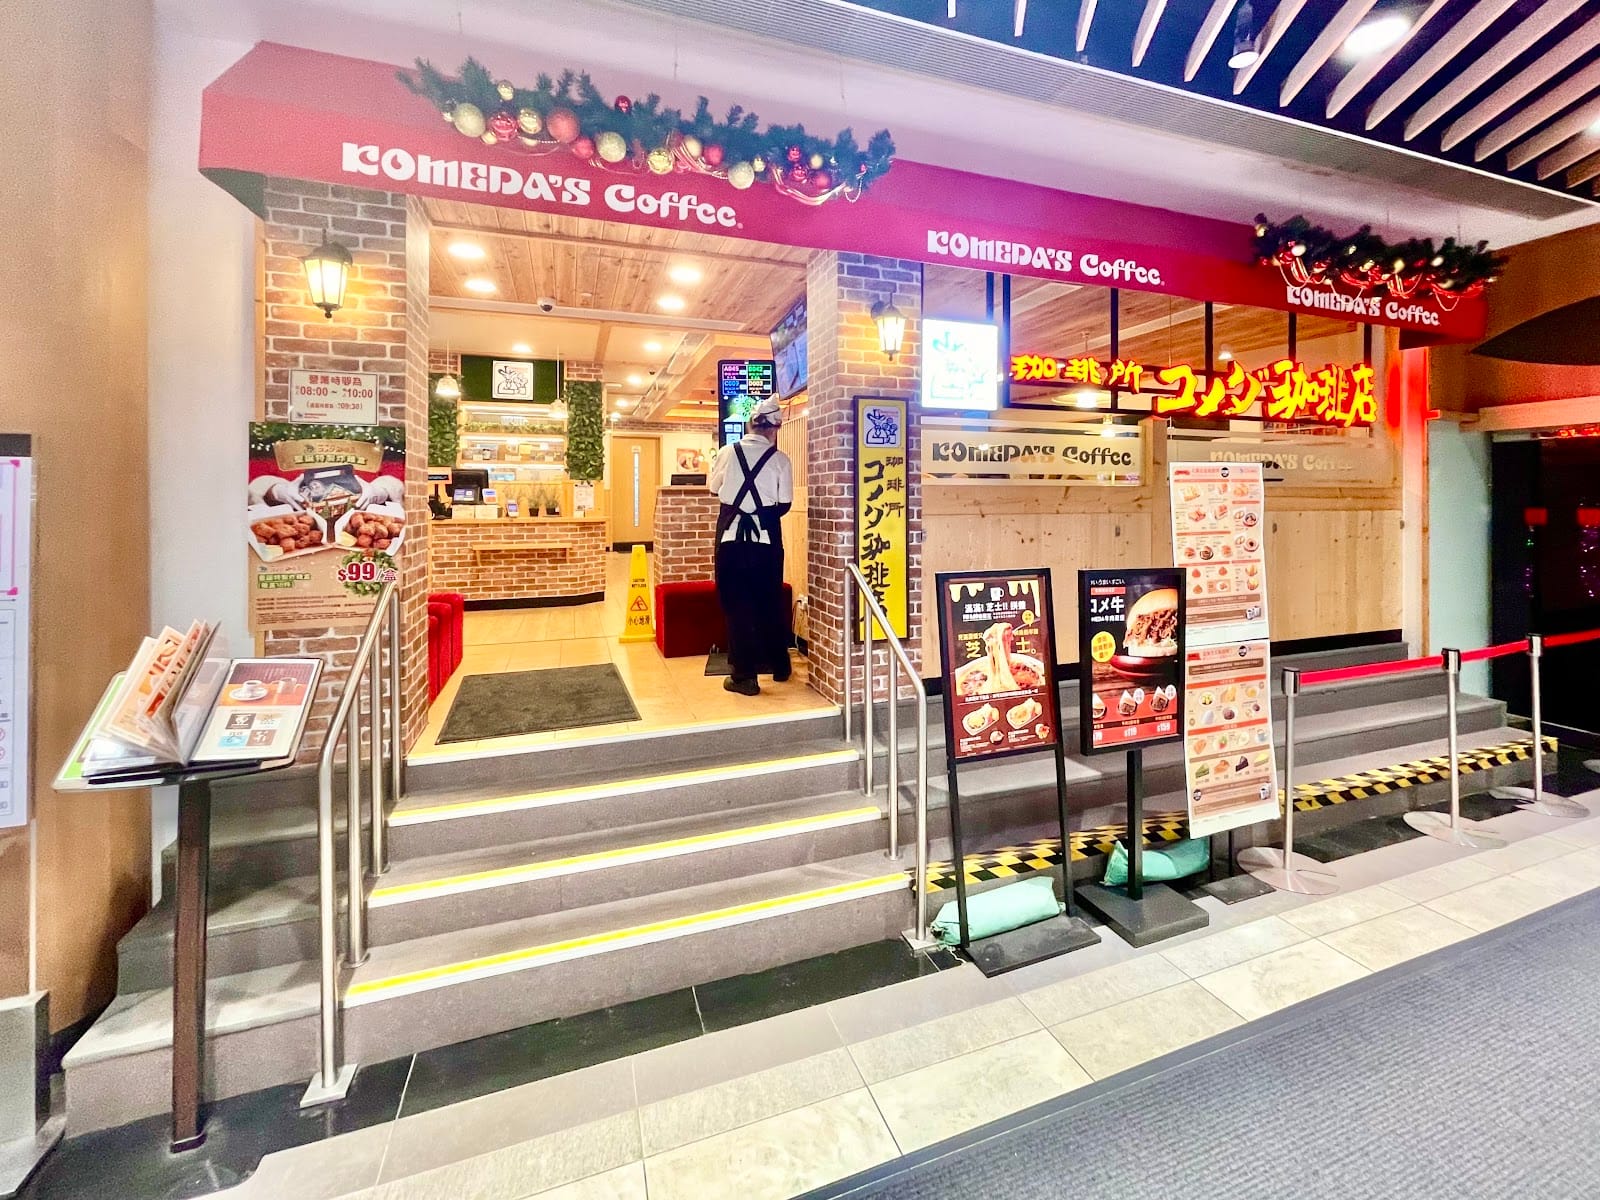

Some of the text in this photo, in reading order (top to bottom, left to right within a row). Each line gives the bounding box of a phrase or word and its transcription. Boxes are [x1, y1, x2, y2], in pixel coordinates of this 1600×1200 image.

[341, 142, 738, 227] KOMEDA'S Coffee
[927, 229, 1162, 286] KOMEDA'S Coffee
[1286, 285, 1440, 326] KOMEDA'S Coffee
[300, 386, 329, 397] 08:00
[347, 388, 373, 398] 10:00
[1154, 359, 1378, 428] コメダ珈琲店
[1062, 446, 1132, 466] Coffee
[1090, 596, 1125, 614] コメ牛
